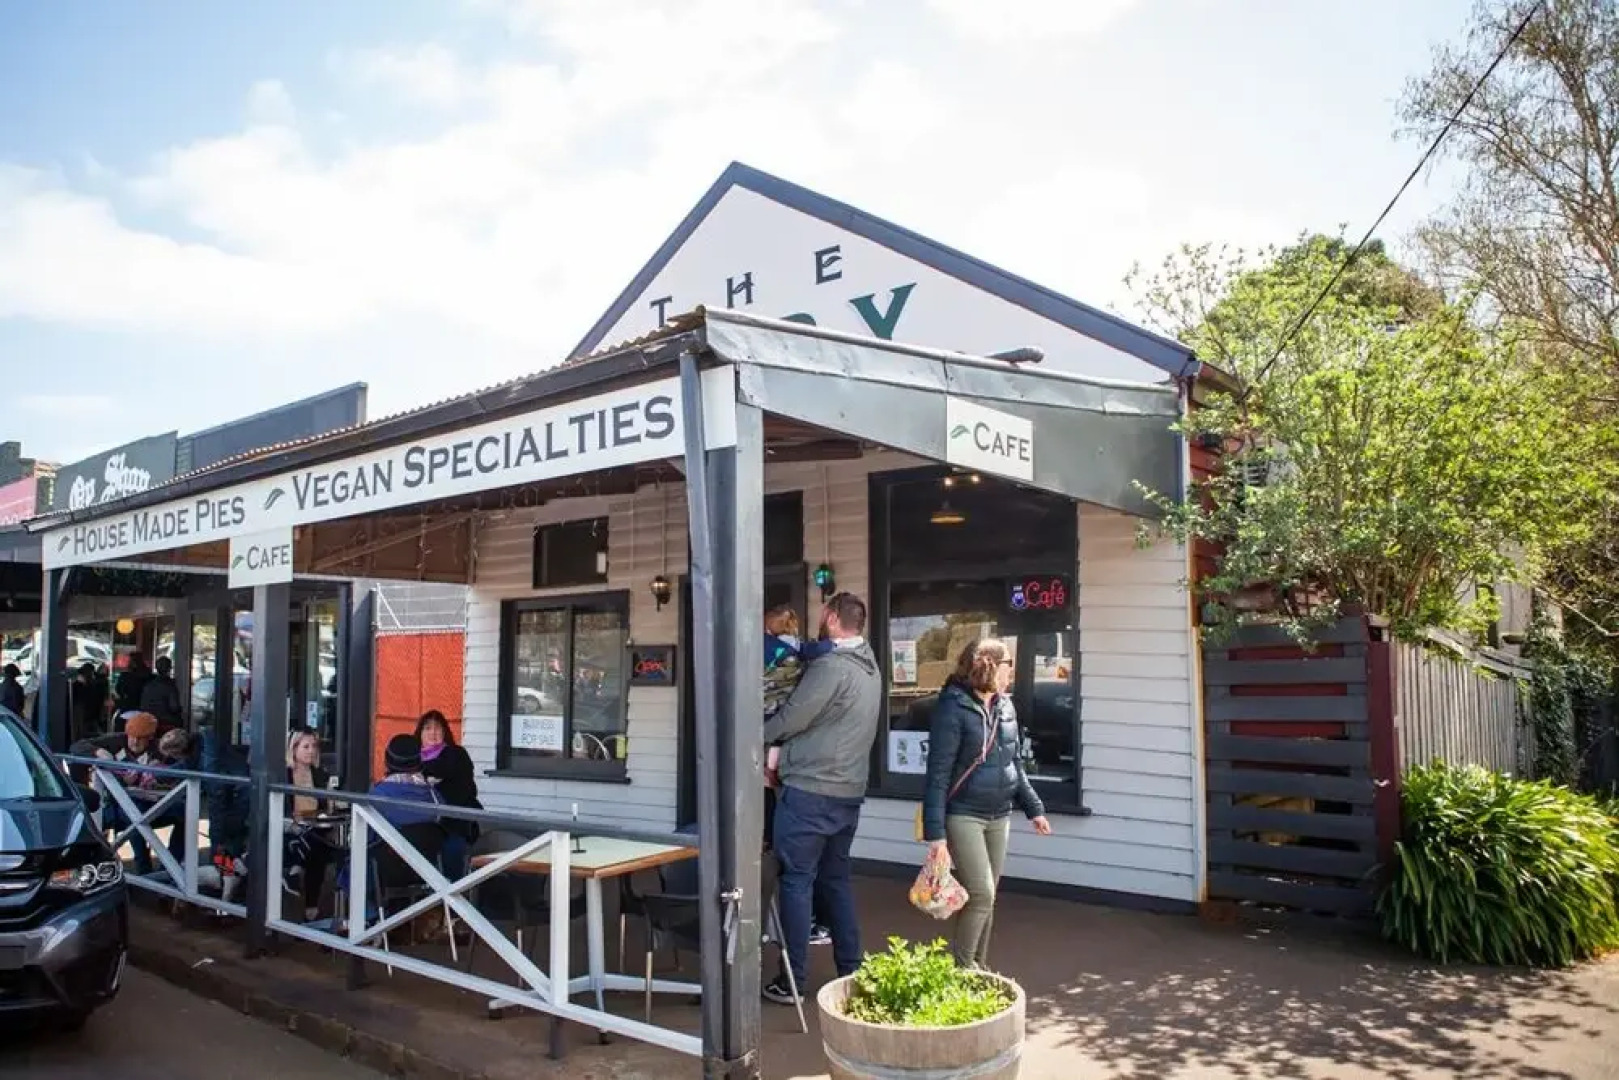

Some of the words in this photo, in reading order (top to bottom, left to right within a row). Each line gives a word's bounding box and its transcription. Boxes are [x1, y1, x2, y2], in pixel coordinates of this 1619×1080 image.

[974, 422, 1030, 461] CAFE
[74, 522, 128, 555] HOUSE
[133, 509, 189, 544] MADE
[196, 497, 245, 532] PIES
[293, 460, 393, 511] VEGAN
[403, 397, 676, 488] SPECIALTIES
[247, 544, 290, 570] CAFE
